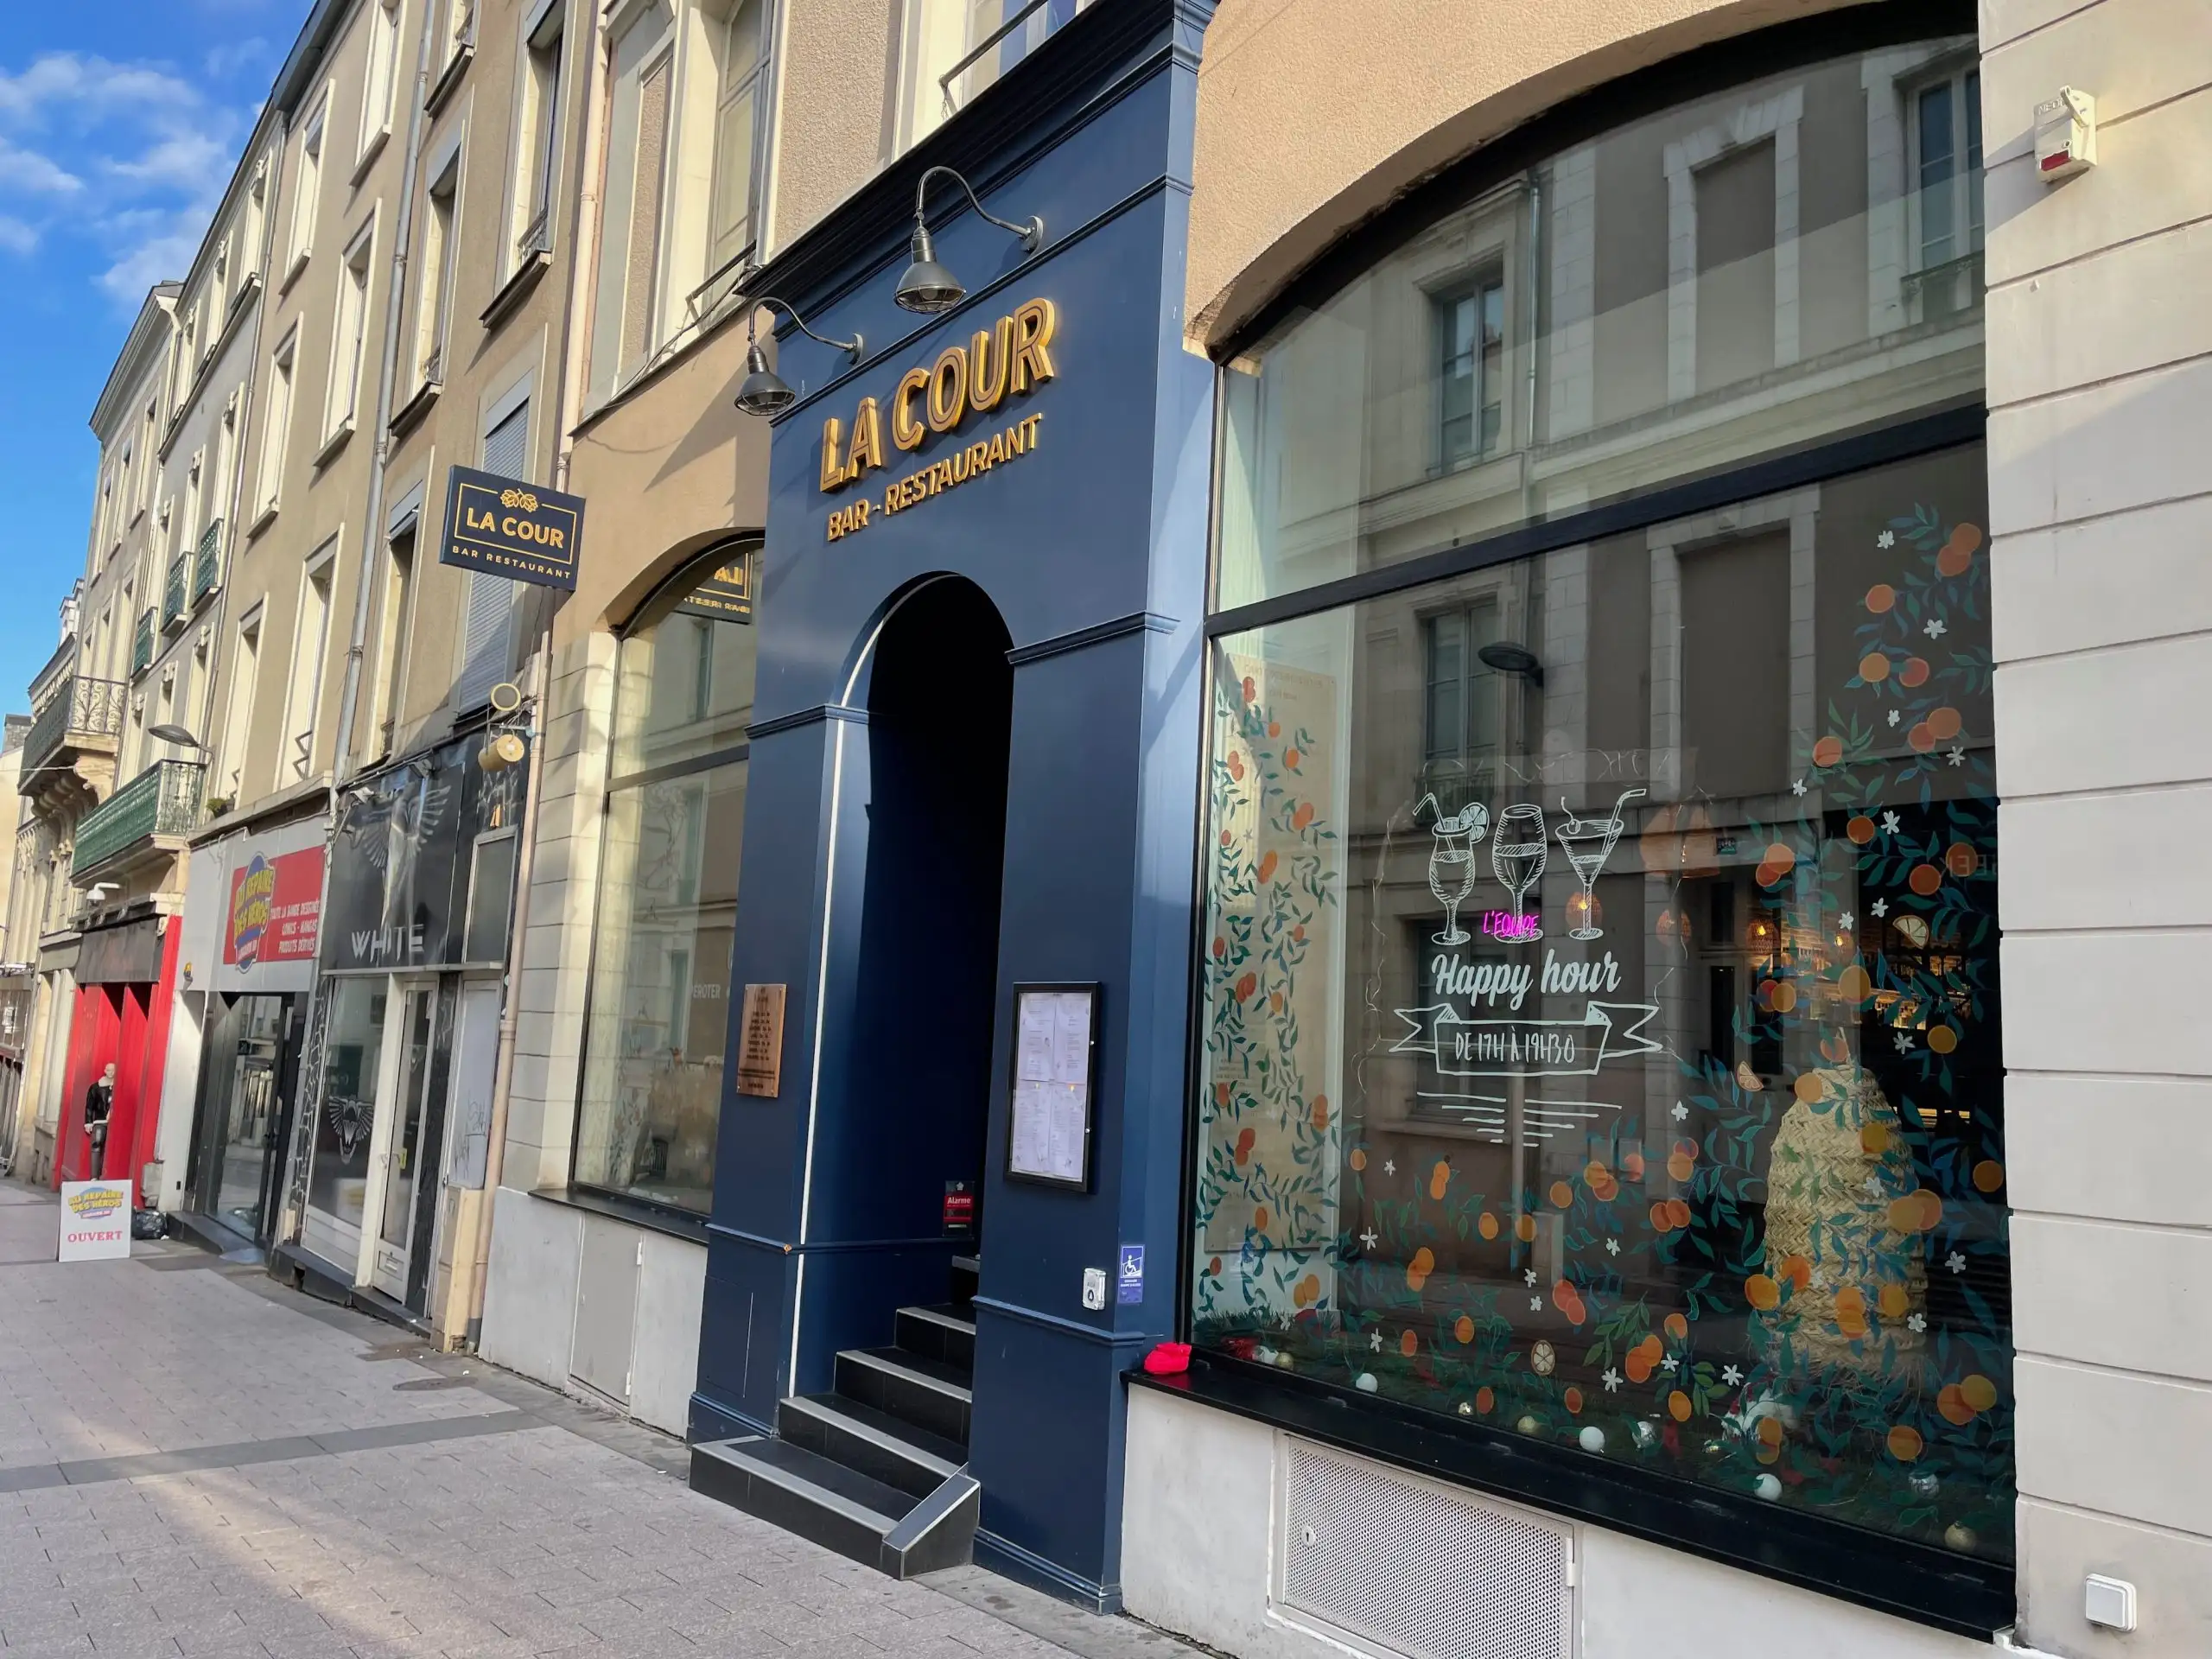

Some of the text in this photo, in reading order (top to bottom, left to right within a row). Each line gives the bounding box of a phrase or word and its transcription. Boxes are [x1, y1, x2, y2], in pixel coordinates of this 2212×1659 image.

[820, 297, 1055, 493] LA COUR
[828, 499, 869, 541] BAR
[885, 412, 1042, 516] RESTAURANT
[467, 507, 564, 549] LA COUR
[452, 545, 571, 580] BAR RESTAURANT
[351, 924, 424, 964] WHITE
[1431, 948, 1622, 1011] Happy hour
[1455, 1025, 1575, 1064] DE 17H À 19H30
[947, 1196, 971, 1205] Alarme
[67, 1230, 122, 1243] OUVERT
